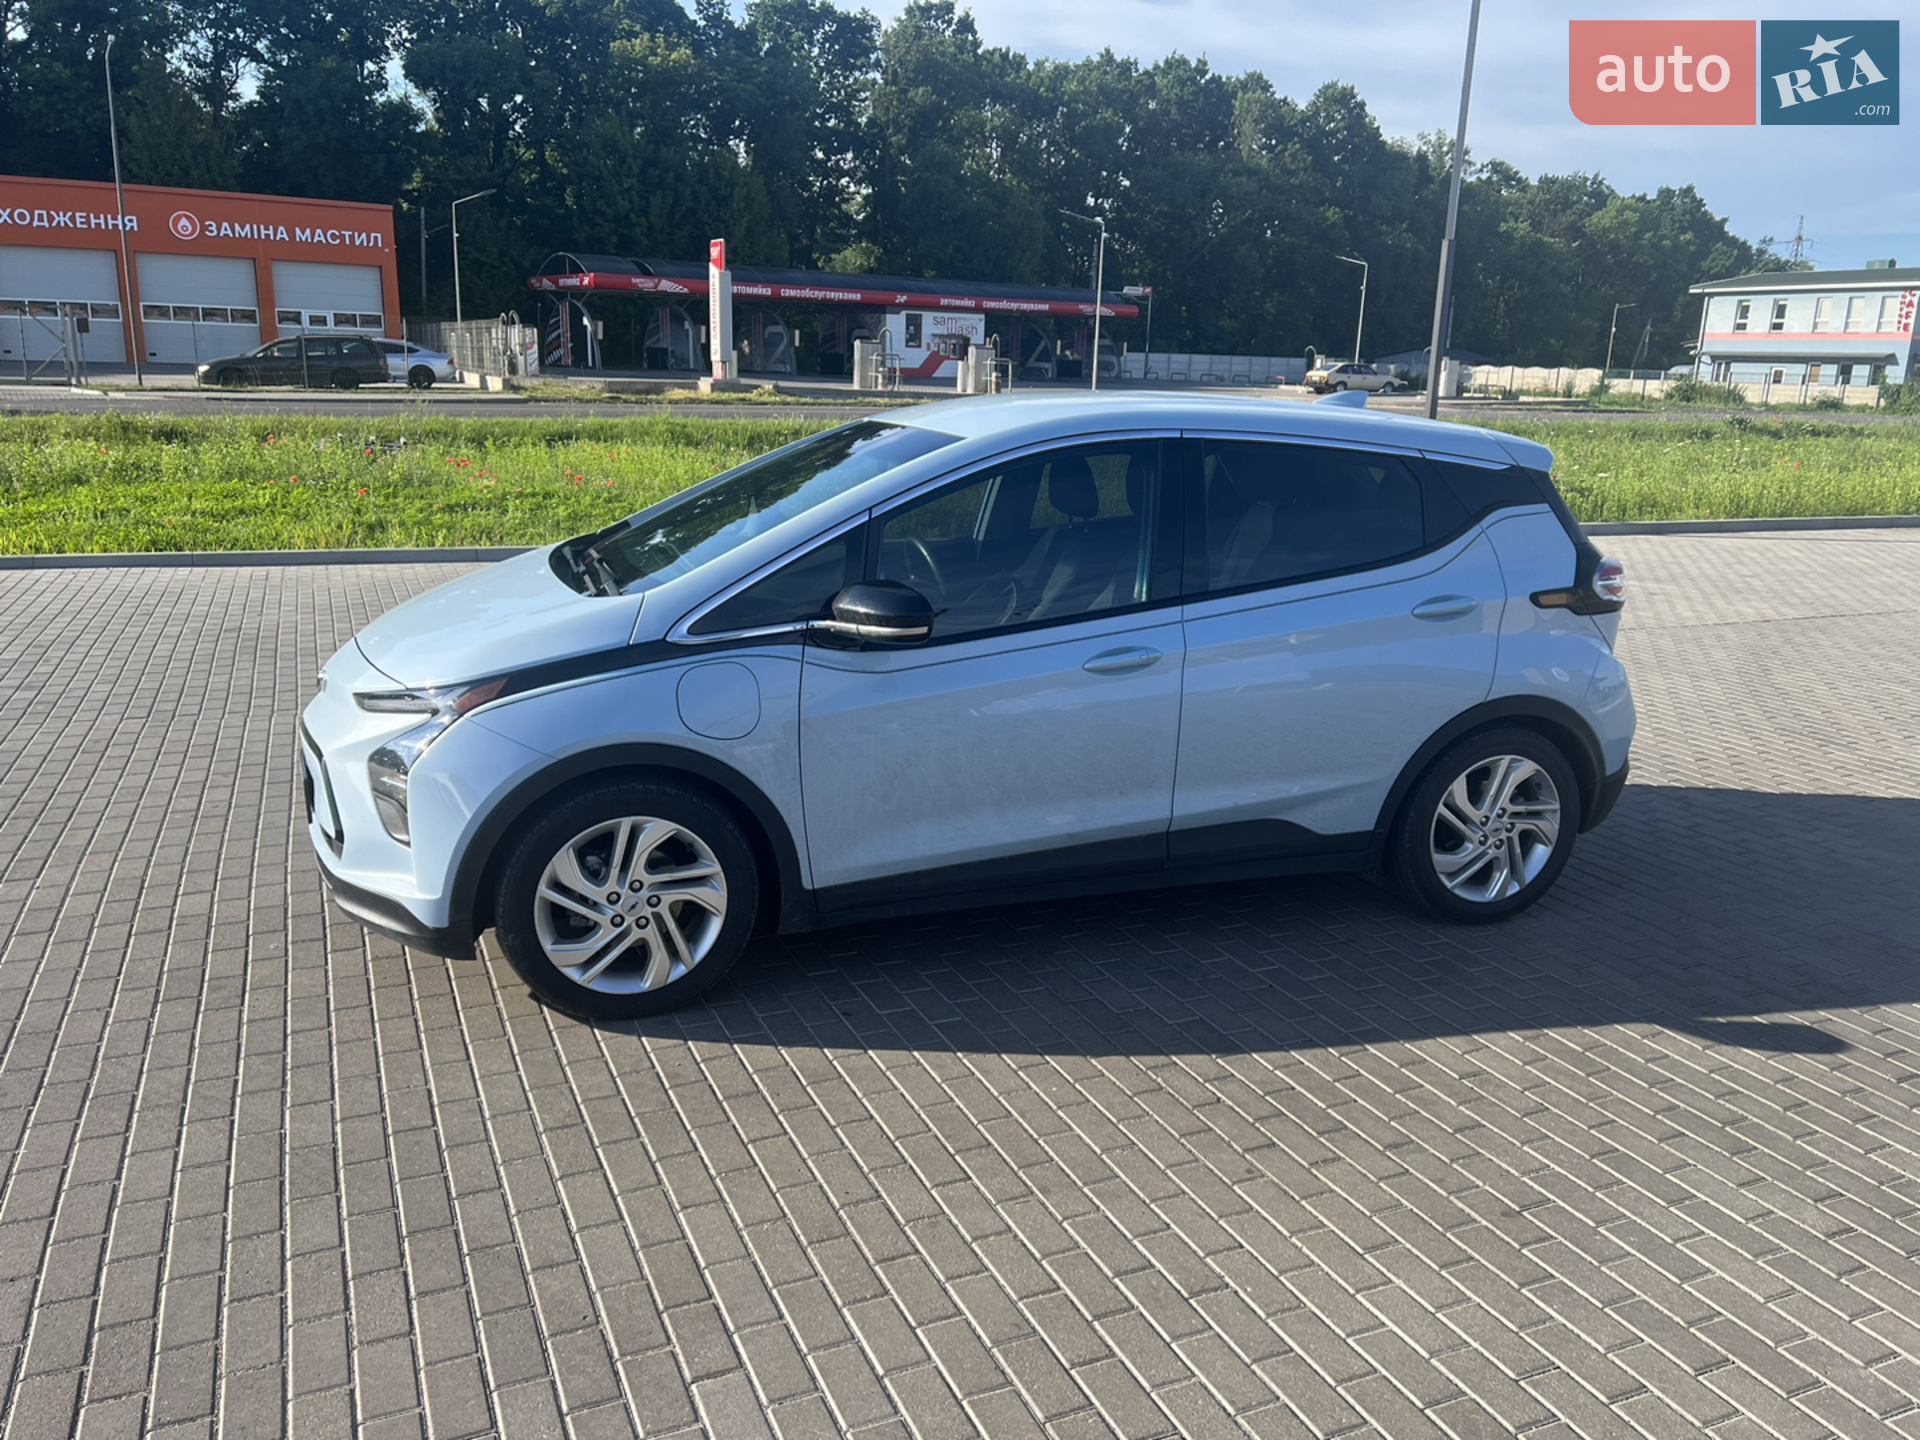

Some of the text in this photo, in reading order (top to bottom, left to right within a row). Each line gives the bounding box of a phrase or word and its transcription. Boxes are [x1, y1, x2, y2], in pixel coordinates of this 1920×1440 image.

[0, 207, 139, 232] ХОДЖЕННЯ
[204, 220, 383, 248] ЗАМІНА МАСТИЛ
[730, 284, 772, 296] втомийка
